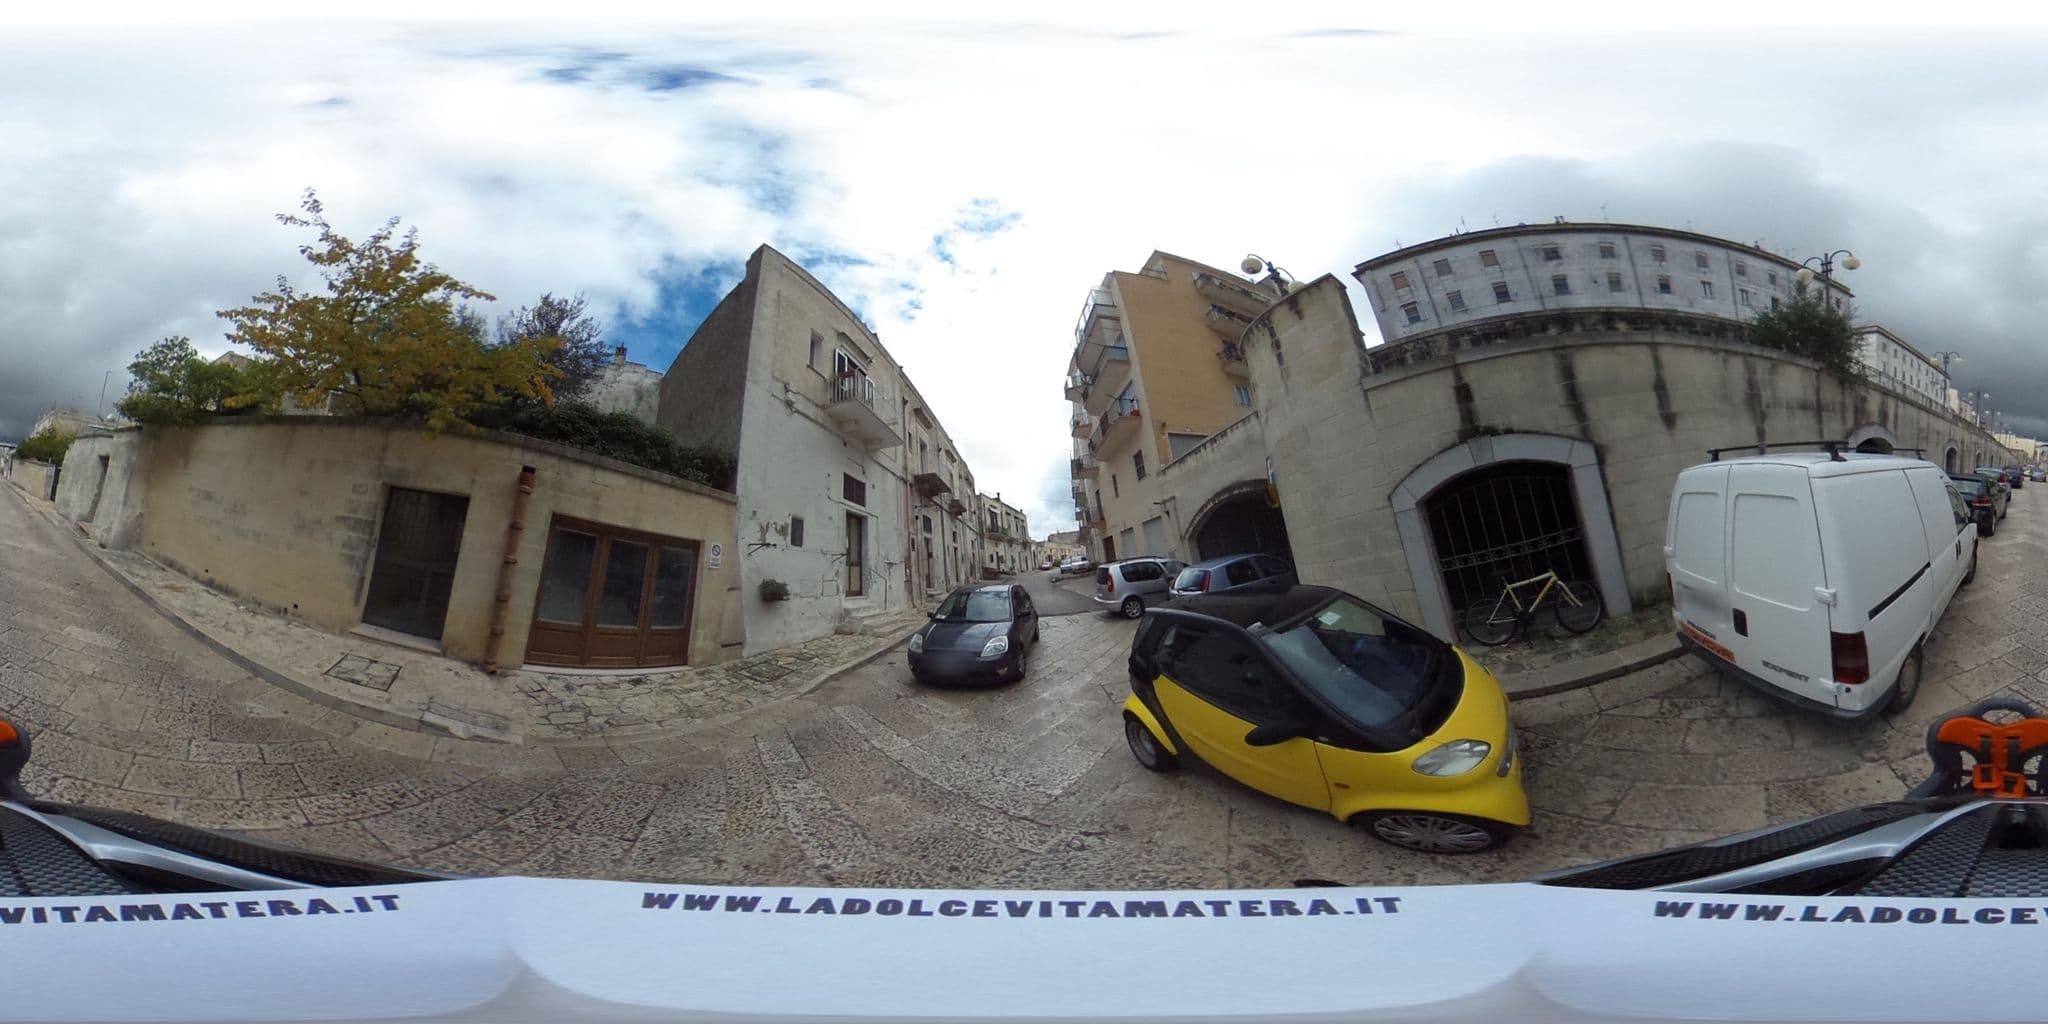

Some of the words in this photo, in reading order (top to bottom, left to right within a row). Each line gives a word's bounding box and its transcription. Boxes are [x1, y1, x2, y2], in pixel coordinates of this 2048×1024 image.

[0, 894, 399, 924] VITAMATERA.IT
[641, 892, 1401, 918] WWW.LADOLCEVITAMATERA.IT
[1654, 901, 2048, 924] WWW.LADOLCE
